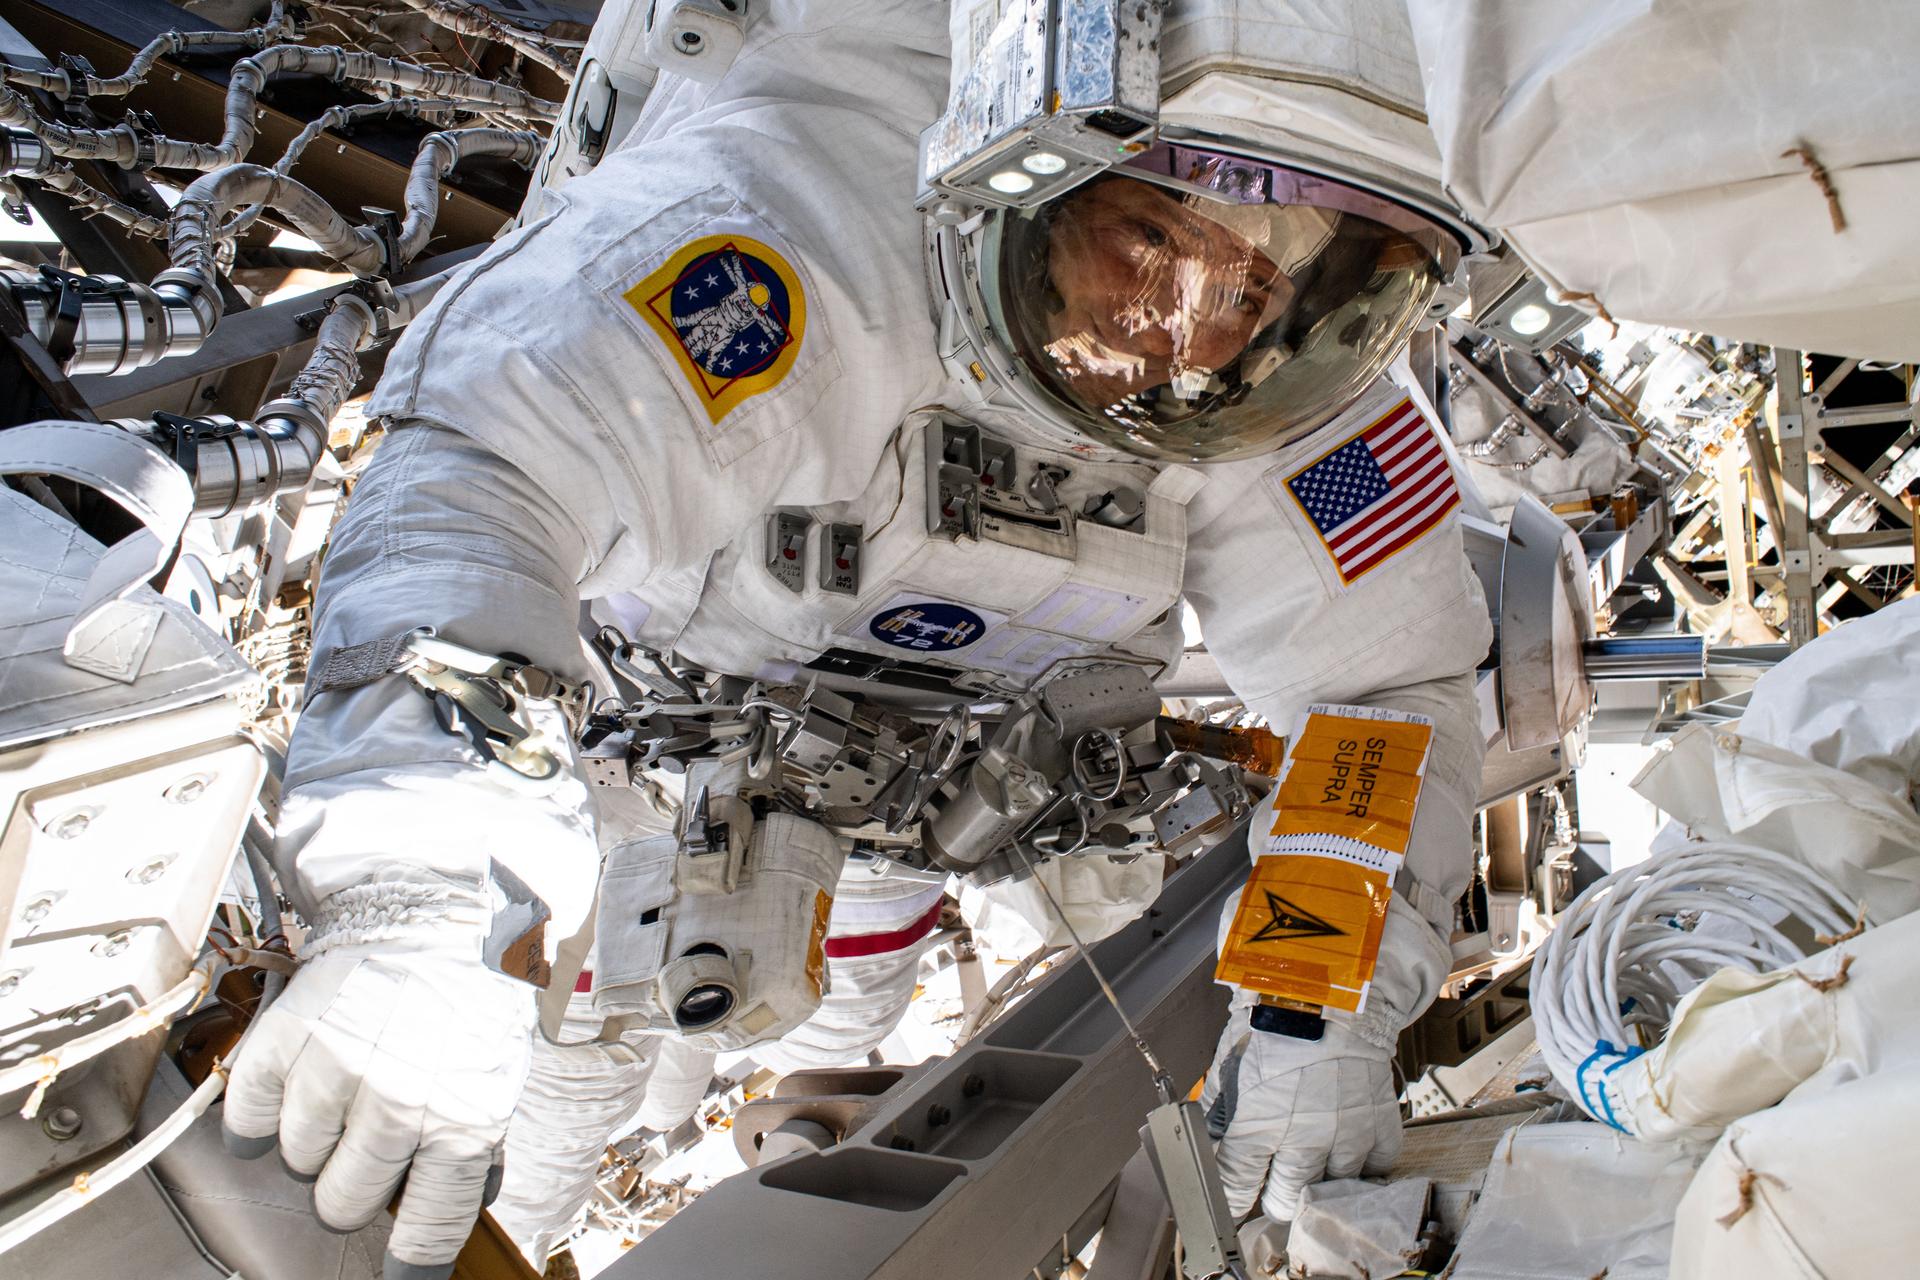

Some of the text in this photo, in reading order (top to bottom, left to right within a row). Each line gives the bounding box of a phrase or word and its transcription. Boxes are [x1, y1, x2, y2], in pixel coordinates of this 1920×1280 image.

[893, 633, 934, 649] 72
[1320, 739, 1358, 804] SUPRA
[1345, 737, 1386, 819] SEMPER
